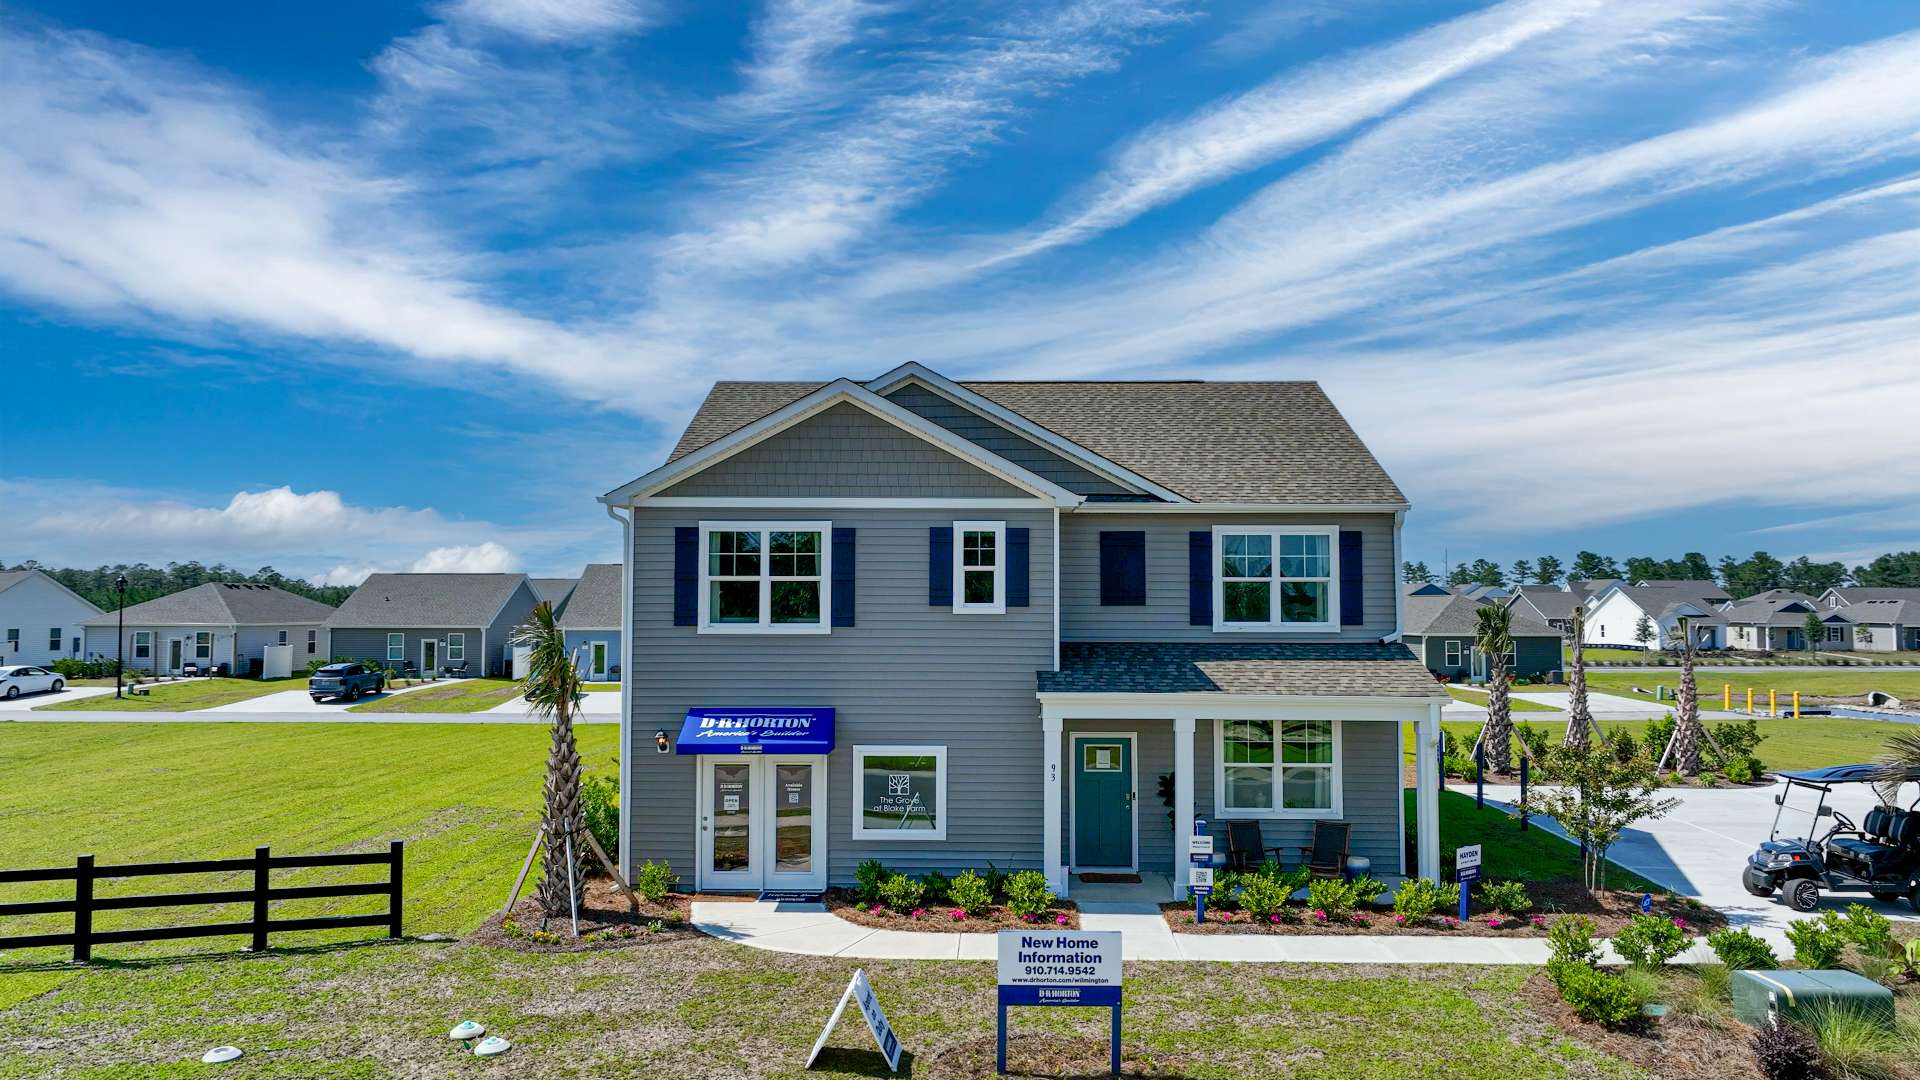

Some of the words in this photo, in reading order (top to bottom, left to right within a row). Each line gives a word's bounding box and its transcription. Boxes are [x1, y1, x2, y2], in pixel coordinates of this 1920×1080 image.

[895, 796, 920, 804] Grove
[883, 804, 905, 812] Blake
[907, 804, 926, 812] Farm
[1460, 850, 1478, 859] HAYDEN
[1021, 936, 1053, 949] New
[1056, 936, 1099, 949] Home
[1018, 951, 1102, 964] Information
[1025, 966, 1096, 976] 910.714.9542
[1012, 976, 1109, 984] www.drhorton.com/wilmington
